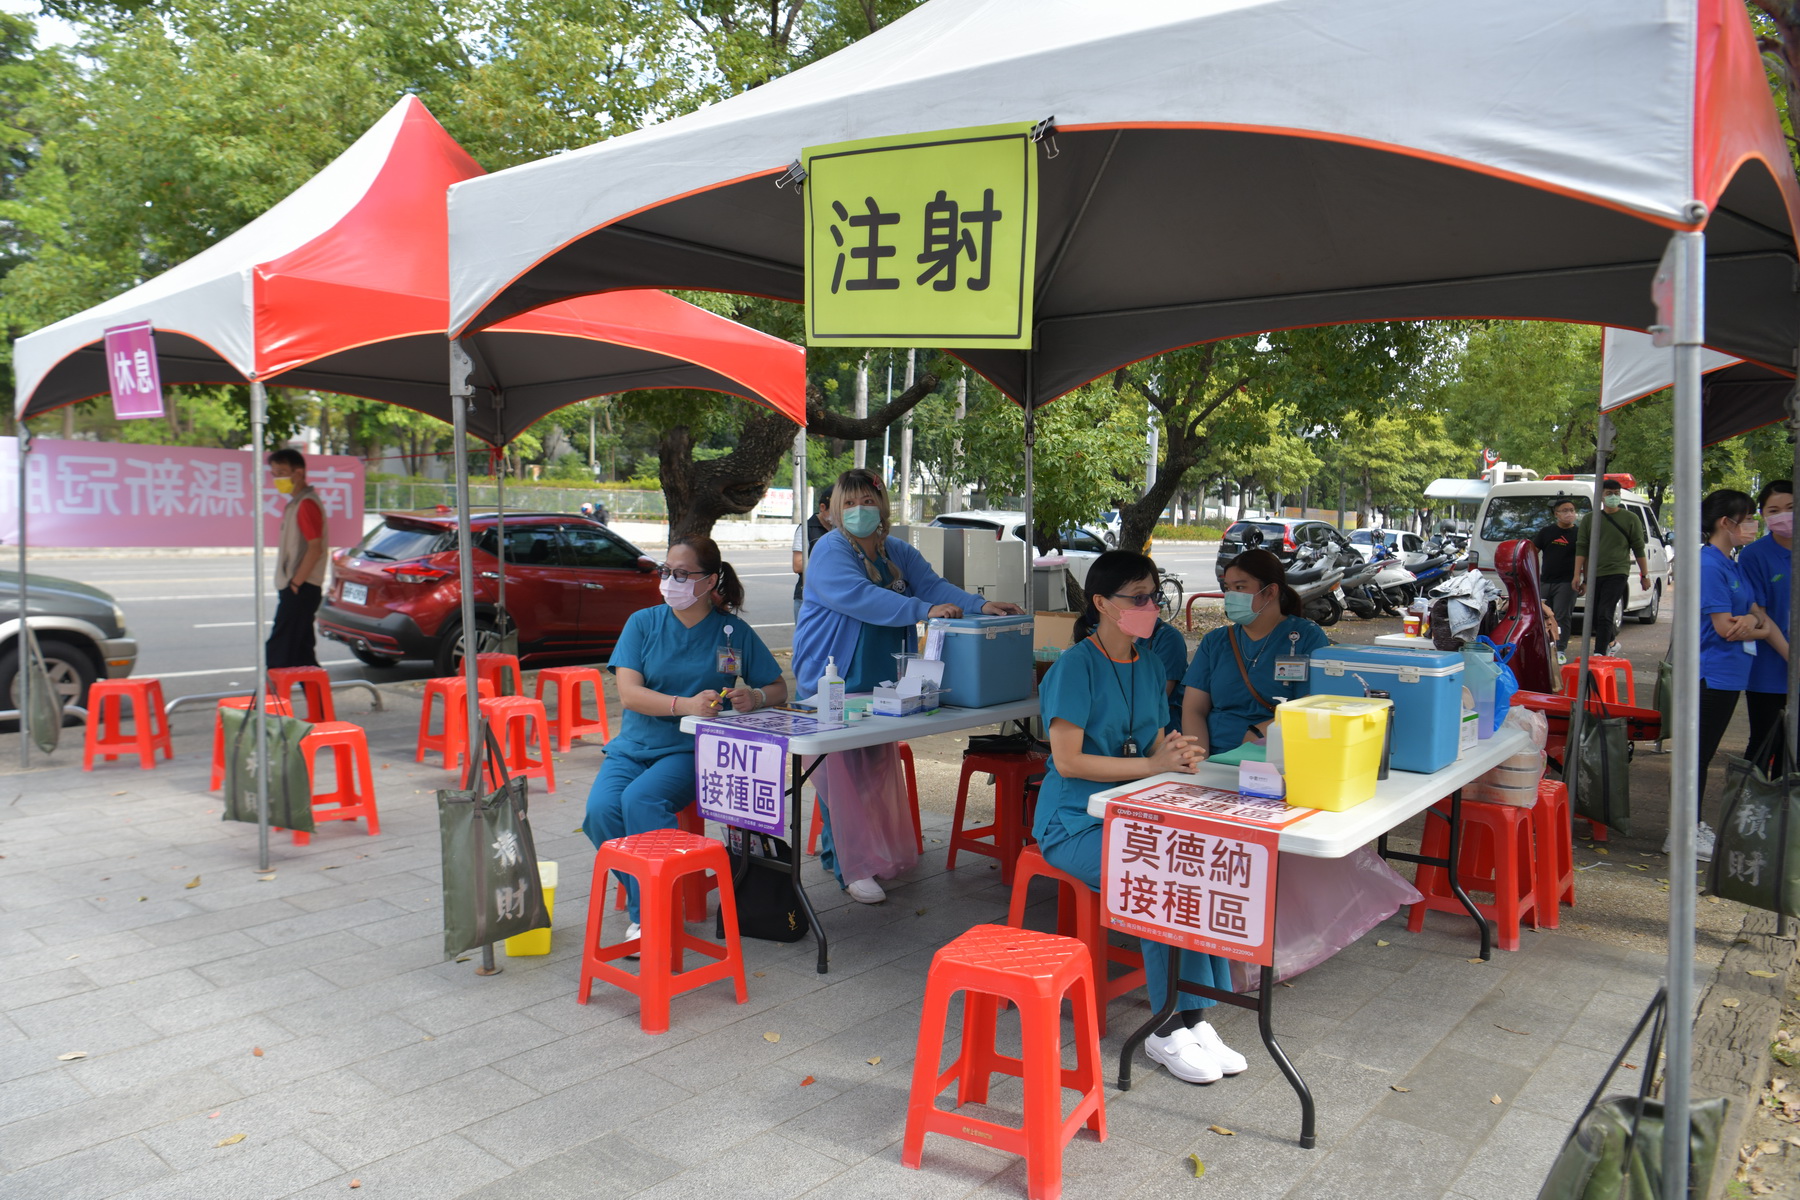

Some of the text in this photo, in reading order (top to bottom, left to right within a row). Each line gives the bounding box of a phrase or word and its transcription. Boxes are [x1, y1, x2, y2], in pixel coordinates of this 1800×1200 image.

[830, 188, 1003, 295] 注射
[113, 348, 155, 396] 休息
[717, 740, 763, 774] BNT
[701, 768, 777, 818] 接種區
[1121, 822, 1252, 889] 莫德納
[1119, 870, 1250, 940] 接種區
